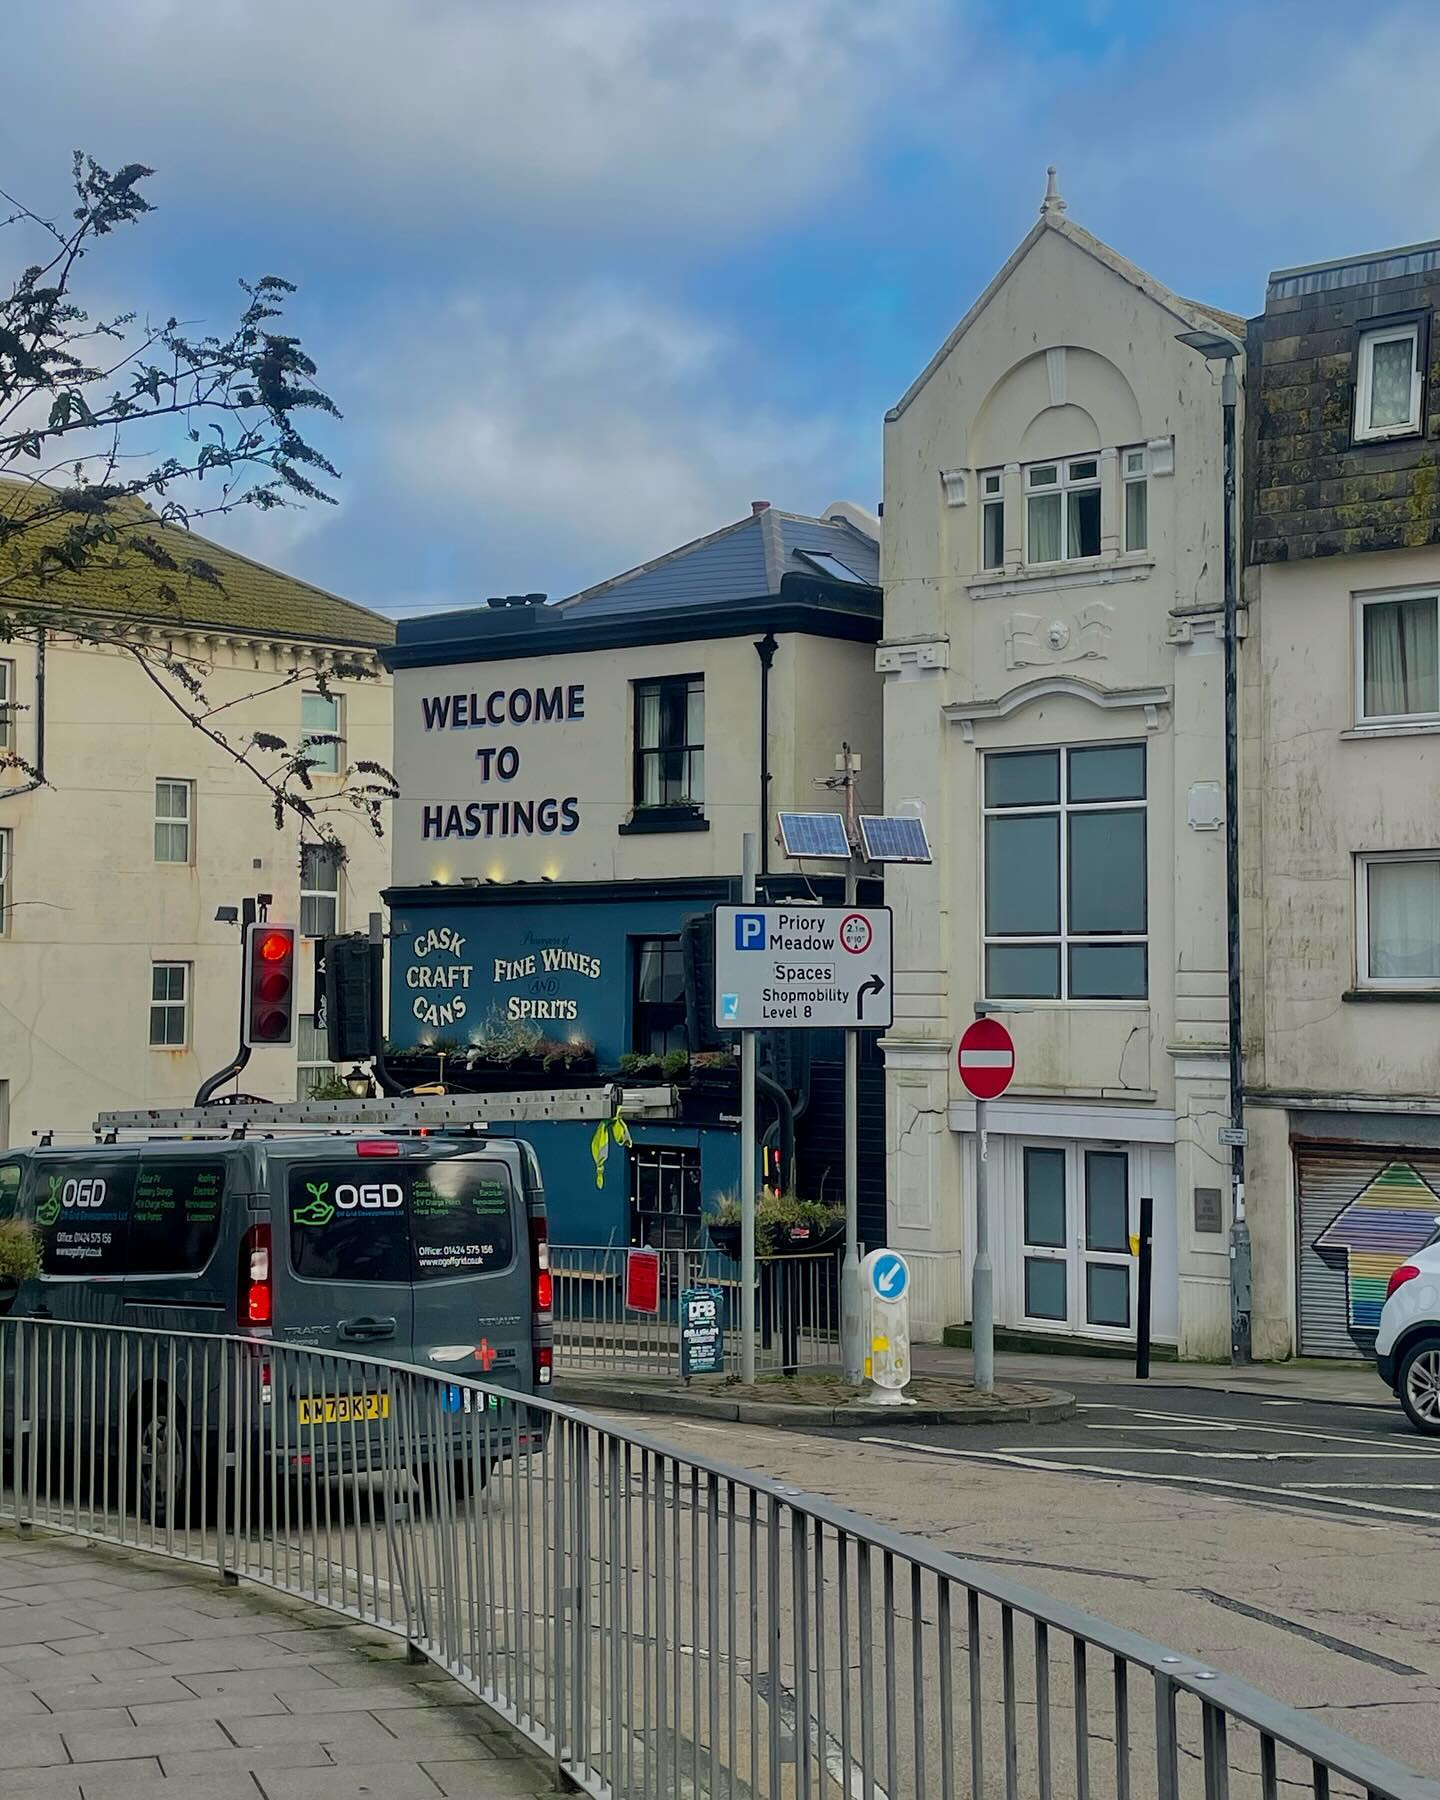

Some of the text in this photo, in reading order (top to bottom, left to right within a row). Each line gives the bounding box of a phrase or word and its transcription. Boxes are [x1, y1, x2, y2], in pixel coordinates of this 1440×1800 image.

[421, 684, 585, 732] WELCOME
[475, 745, 520, 783] TO
[421, 797, 581, 840] HASTINGS
[742, 917, 762, 948] P
[778, 914, 825, 933] Priory
[413, 927, 467, 958] CASK
[769, 934, 835, 951] Meadow
[406, 965, 473, 989] CRAFT
[493, 948, 601, 983] FINE WINES
[775, 964, 832, 982] Spaces
[507, 996, 578, 1021] SPIRITS
[762, 988, 849, 1004] Shopmobility
[412, 995, 467, 1027] CANS
[762, 1005, 812, 1019] Level 8
[62, 1178, 106, 1208] OGD
[334, 1183, 403, 1208] OGD
[443, 1245, 465, 1255] 01424
[466, 1245, 480, 1255] 575
